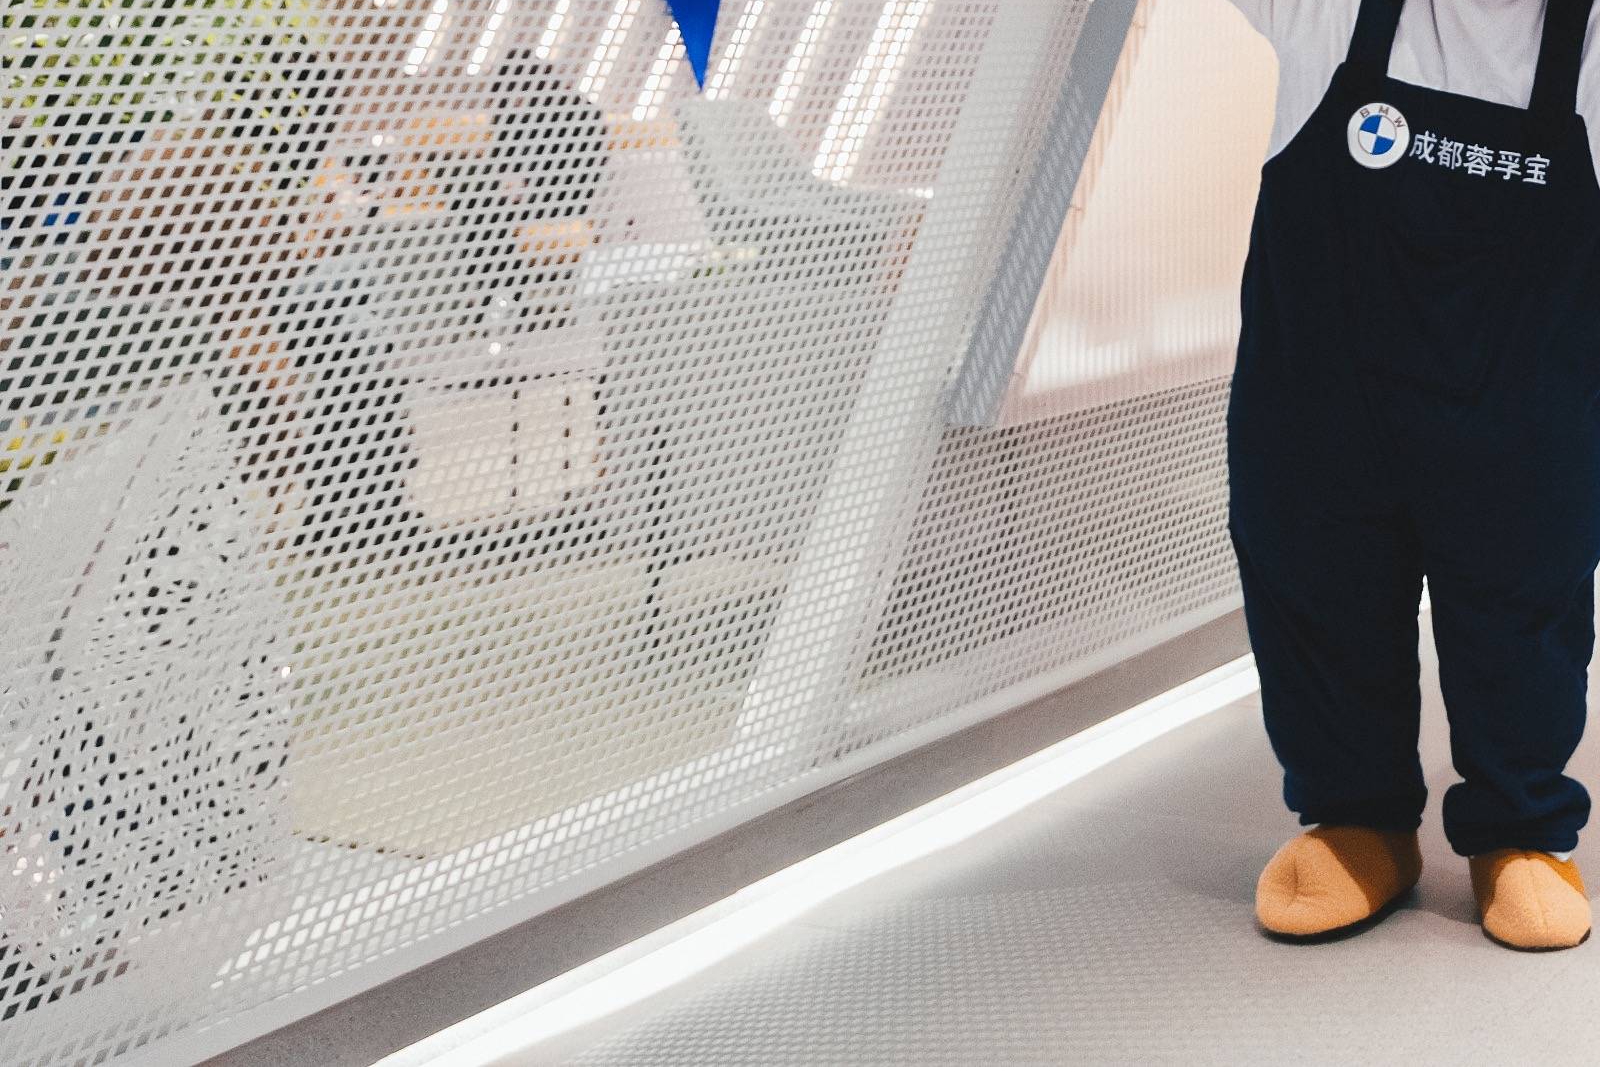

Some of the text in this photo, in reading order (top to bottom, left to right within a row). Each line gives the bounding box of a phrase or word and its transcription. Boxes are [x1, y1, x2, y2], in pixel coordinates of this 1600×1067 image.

[1409, 130, 1550, 184] 成都蓉孚宝
